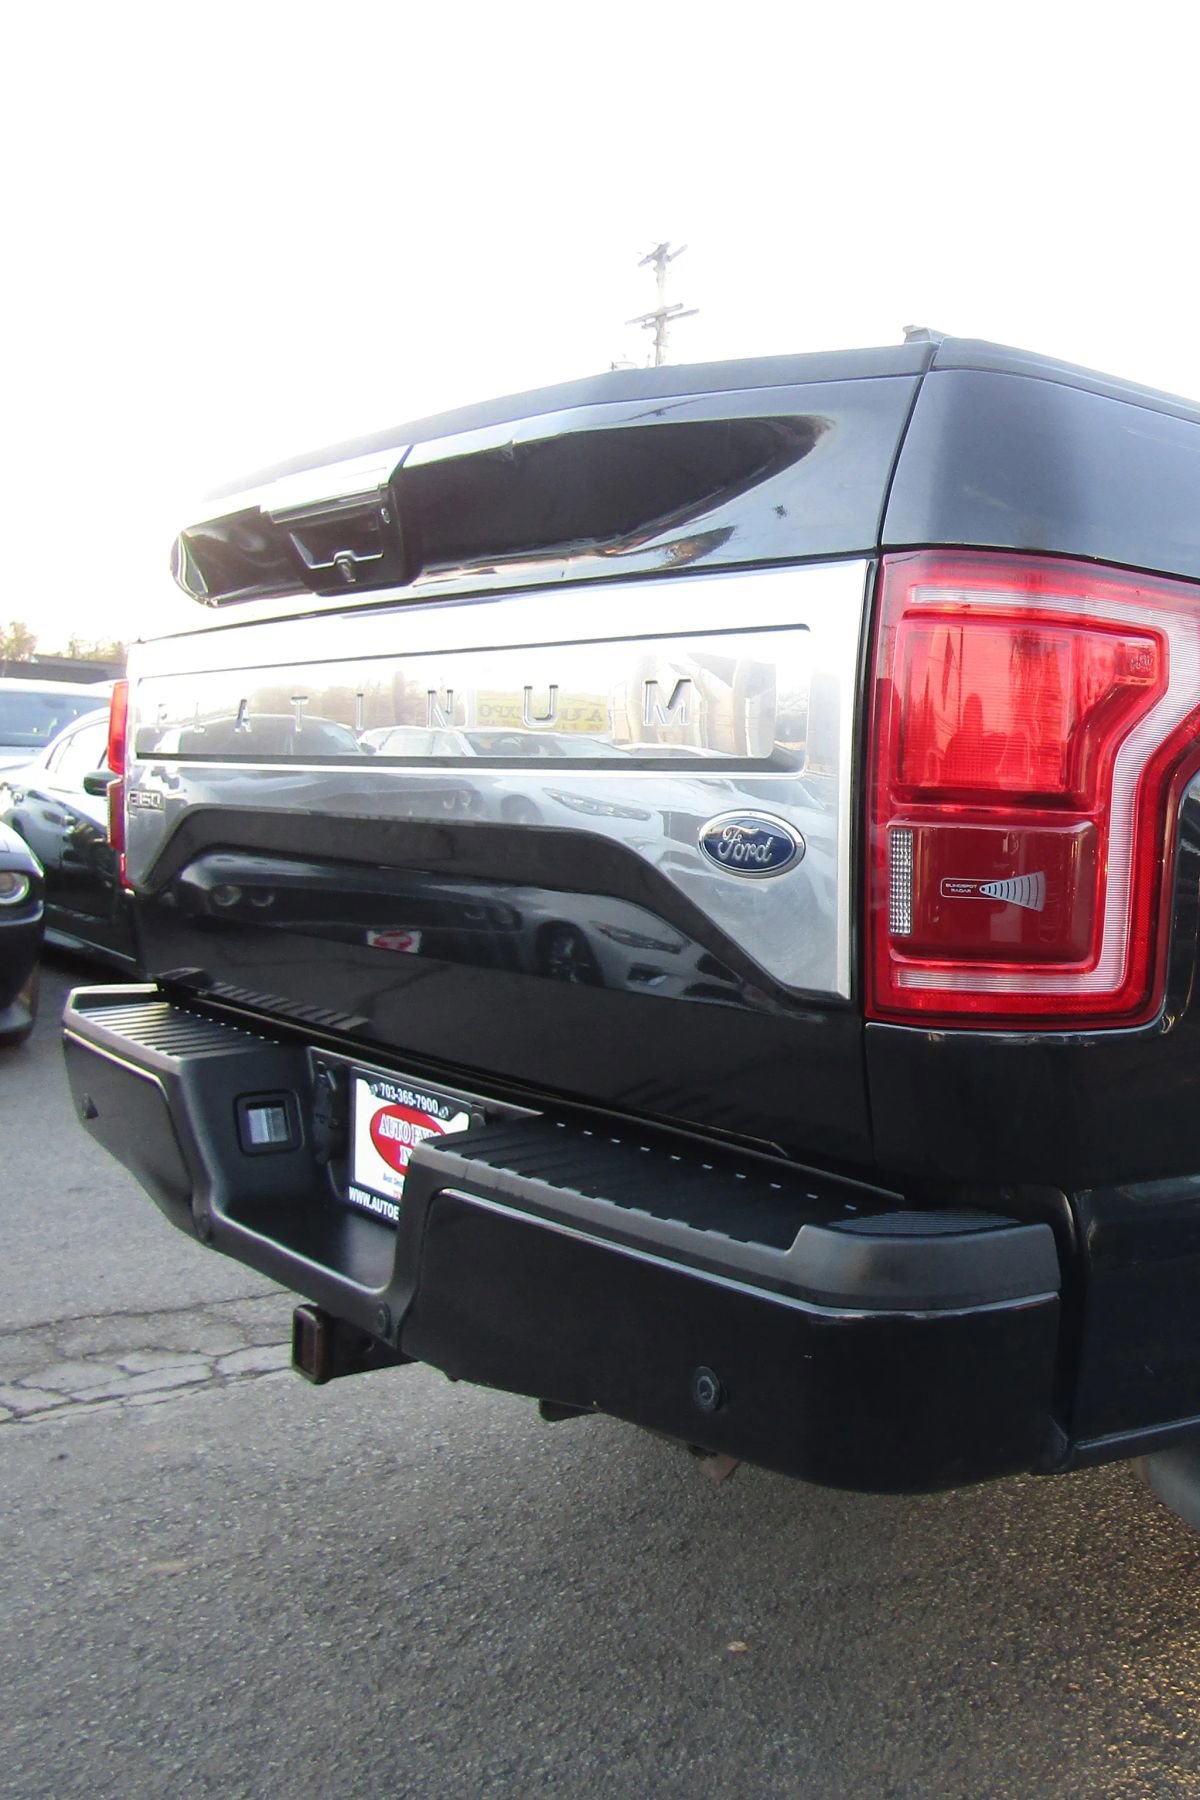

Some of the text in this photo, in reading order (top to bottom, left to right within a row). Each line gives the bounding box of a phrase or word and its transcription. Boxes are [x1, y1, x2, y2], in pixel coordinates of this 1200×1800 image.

[718, 824, 775, 863] Ford
[380, 1082, 439, 1114] 703-365-7900
[379, 1113, 411, 1144] AUTO
